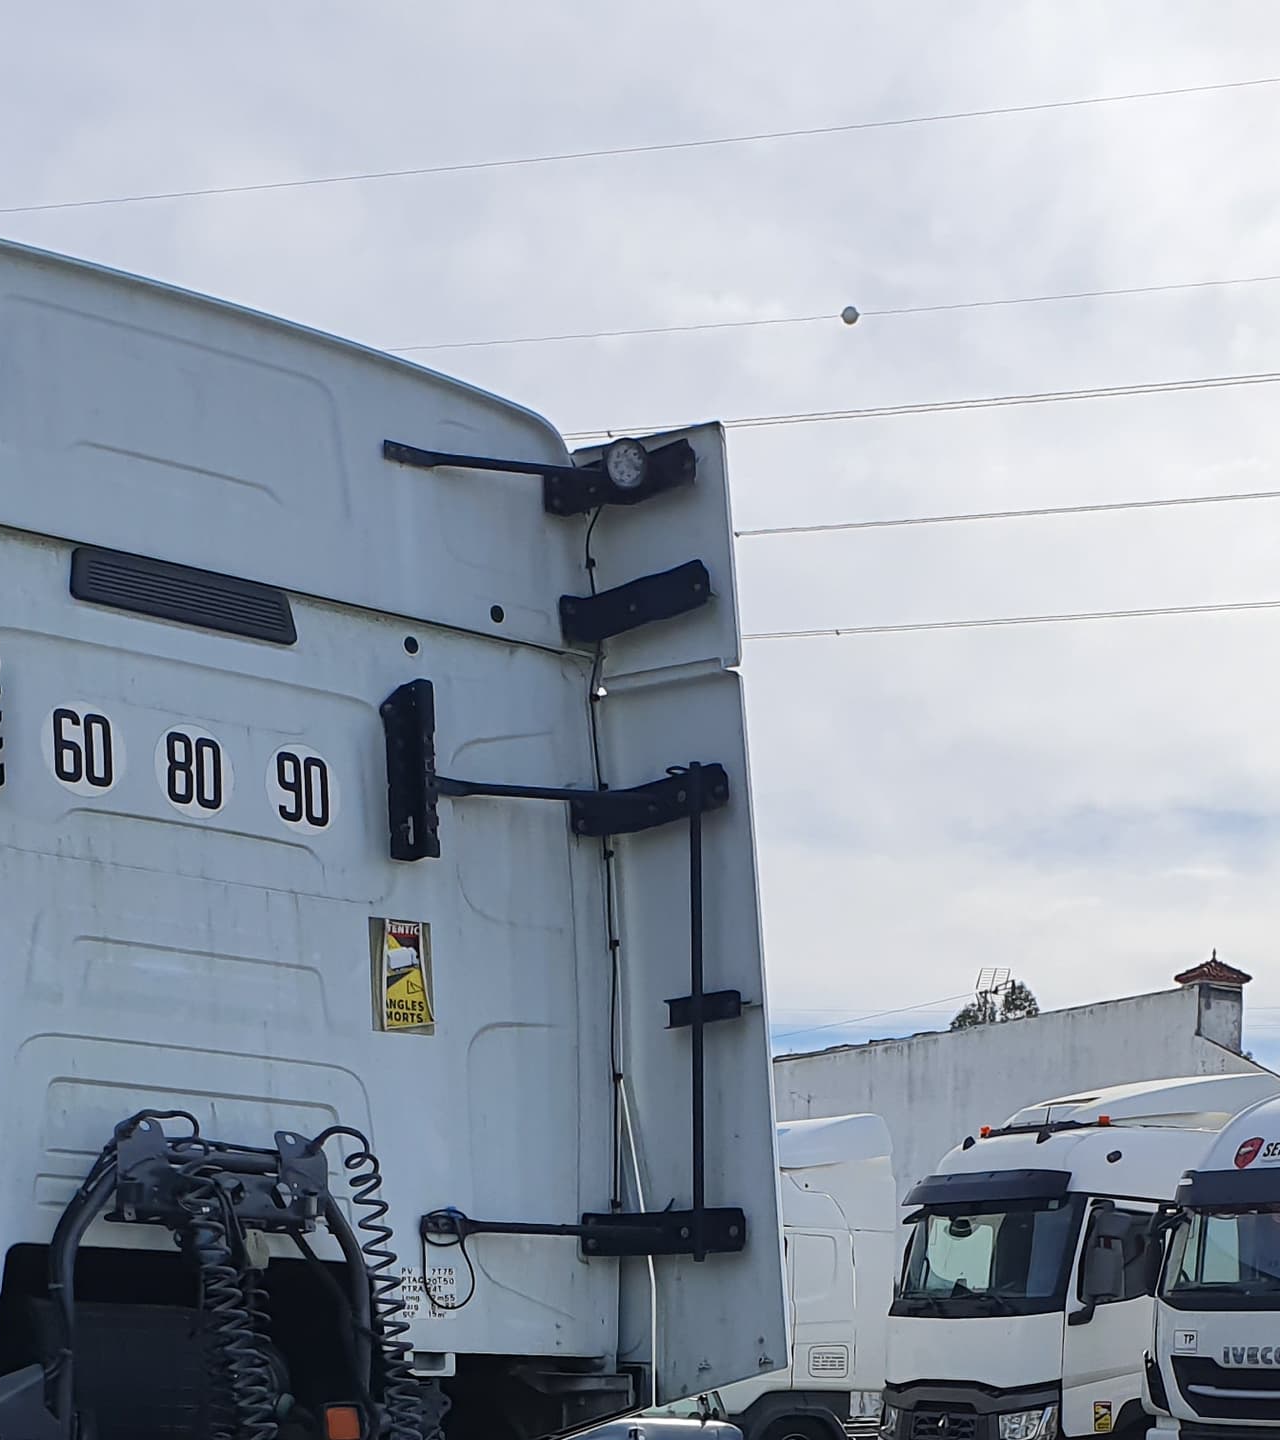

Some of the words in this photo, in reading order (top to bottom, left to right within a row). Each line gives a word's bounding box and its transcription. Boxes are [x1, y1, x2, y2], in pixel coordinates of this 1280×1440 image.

[52, 707, 113, 788] 60
[166, 731, 221, 810] 80
[276, 751, 330, 828] 90
[1183, 1334, 1195, 1345] TP
